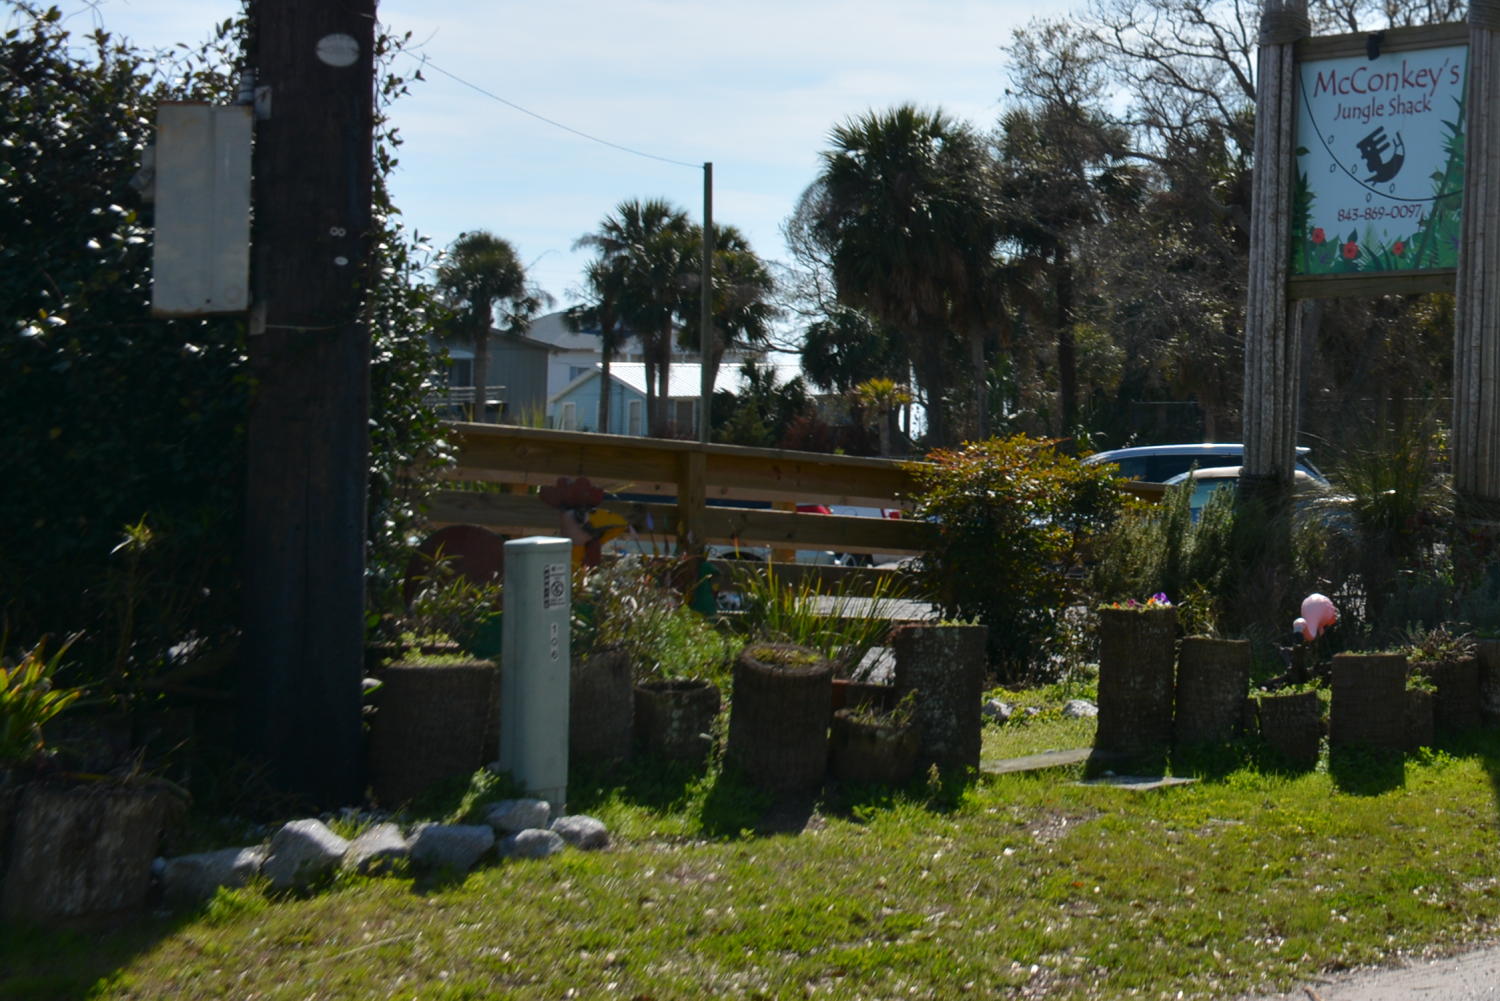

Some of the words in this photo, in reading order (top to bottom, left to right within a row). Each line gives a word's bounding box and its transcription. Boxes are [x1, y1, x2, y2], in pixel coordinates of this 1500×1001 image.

[1313, 57, 1460, 97] McConkey's
[1334, 96, 1385, 124] Jungle
[1388, 93, 1432, 116] Shack
[1337, 203, 1422, 222] 843-869-0097
